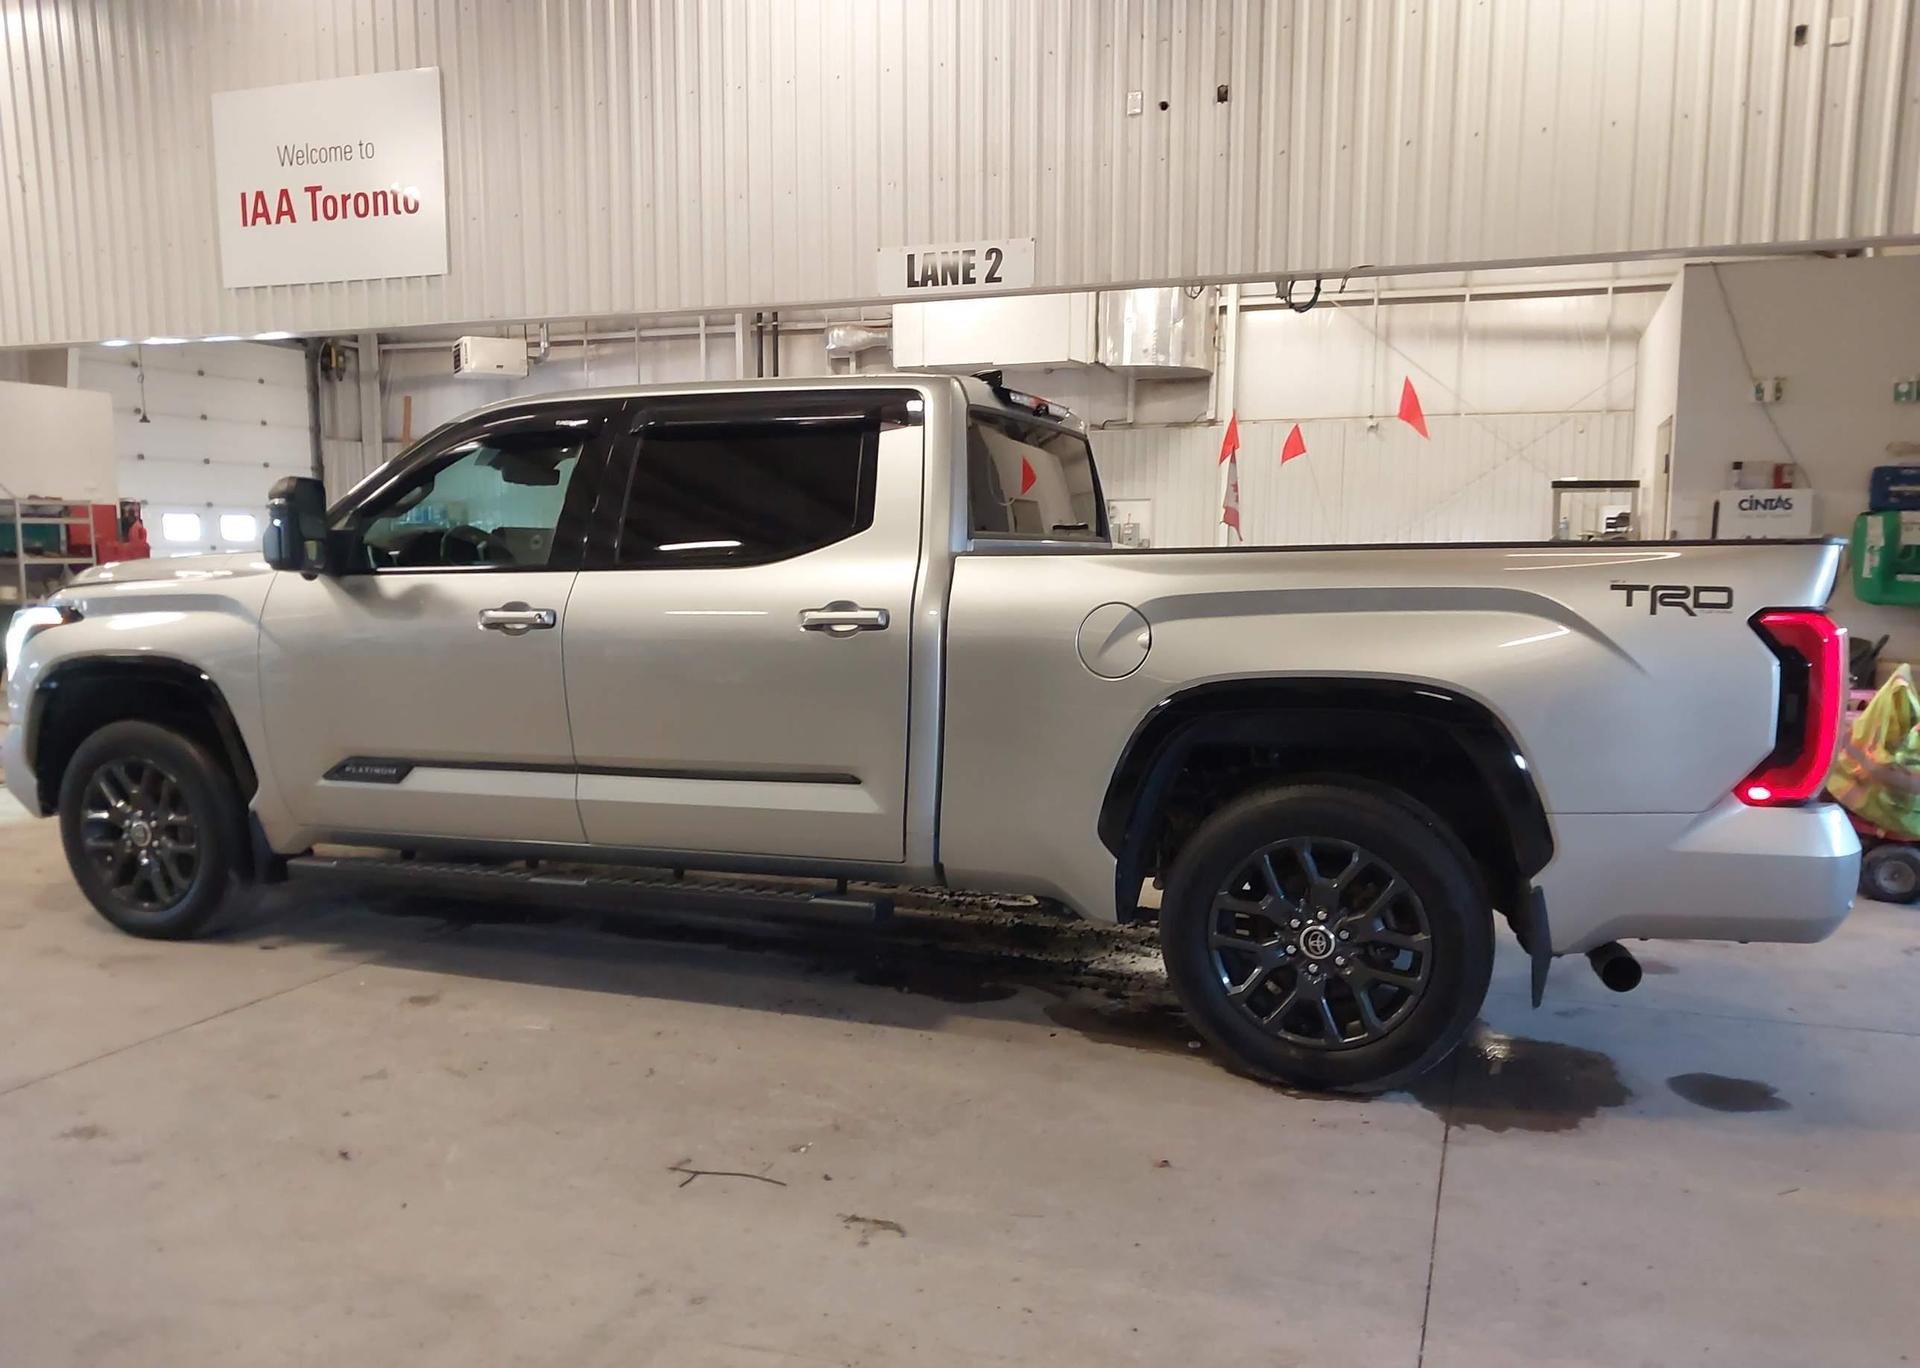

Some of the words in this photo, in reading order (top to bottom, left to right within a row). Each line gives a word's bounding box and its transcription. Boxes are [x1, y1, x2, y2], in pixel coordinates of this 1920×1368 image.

[276, 142, 353, 167] Welcome
[358, 139, 375, 160] to
[240, 188, 297, 228] IAA
[304, 184, 420, 222] Toronto
[907, 249, 977, 288] LANE
[984, 247, 1003, 284] 2
[1610, 584, 1733, 616] TRD
